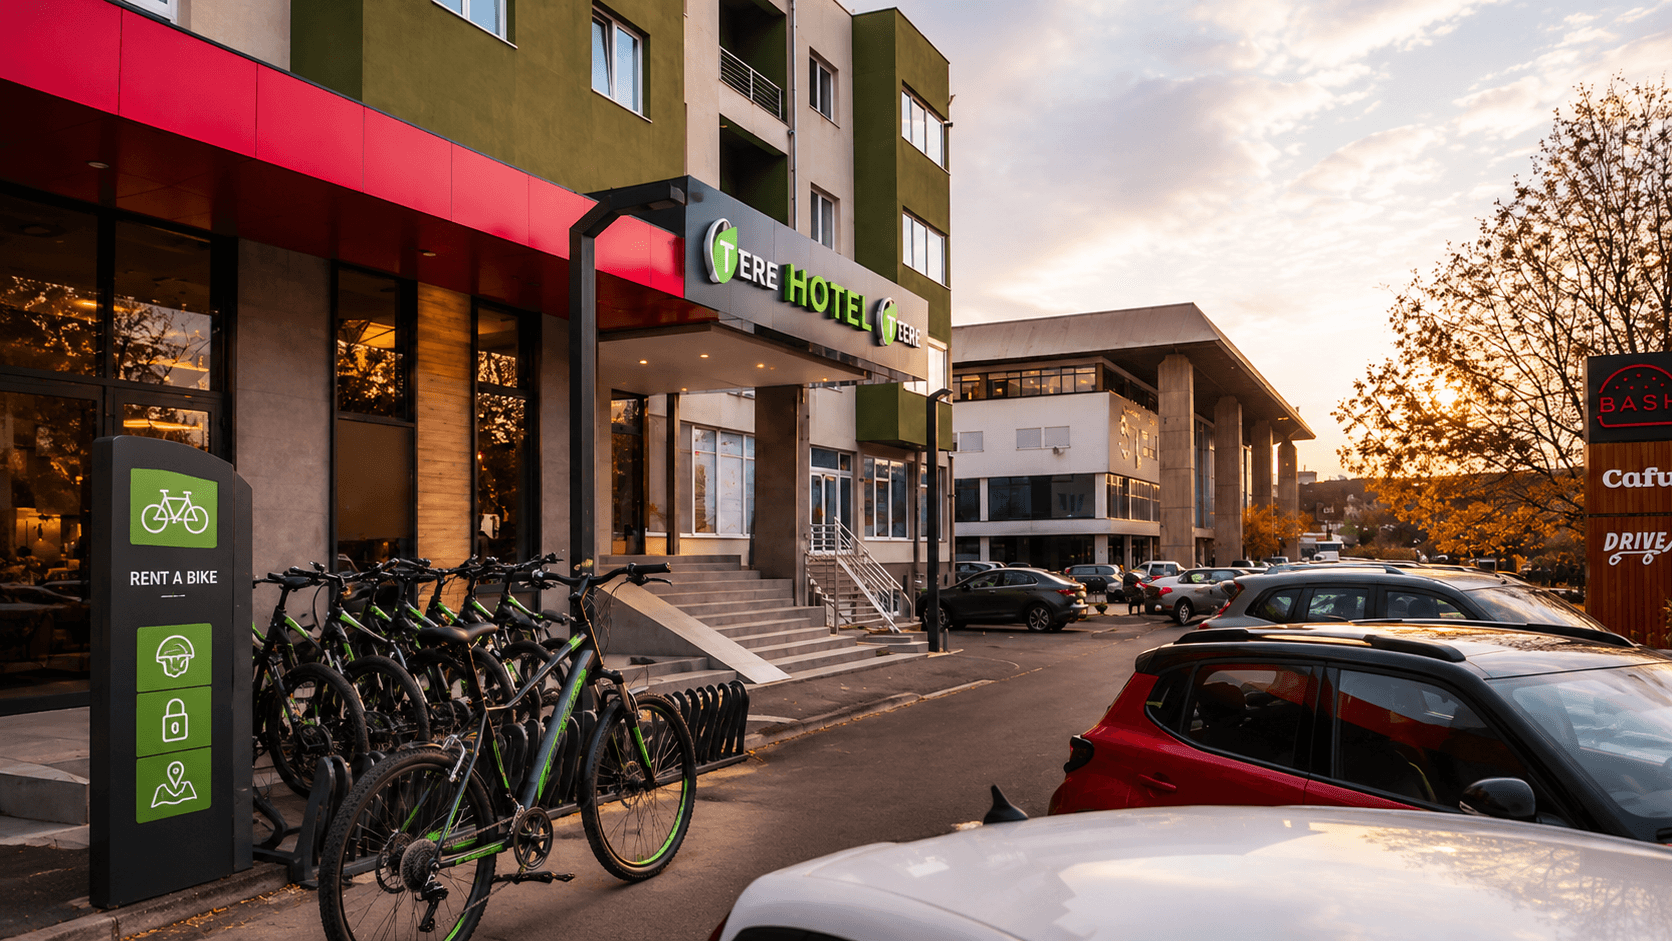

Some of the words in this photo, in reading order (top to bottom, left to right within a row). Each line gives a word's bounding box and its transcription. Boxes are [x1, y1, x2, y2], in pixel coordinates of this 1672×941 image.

[786, 263, 873, 332] HOTEL
[130, 571, 170, 586] RENT
[172, 570, 183, 585] A
[187, 570, 218, 584] BIKE
